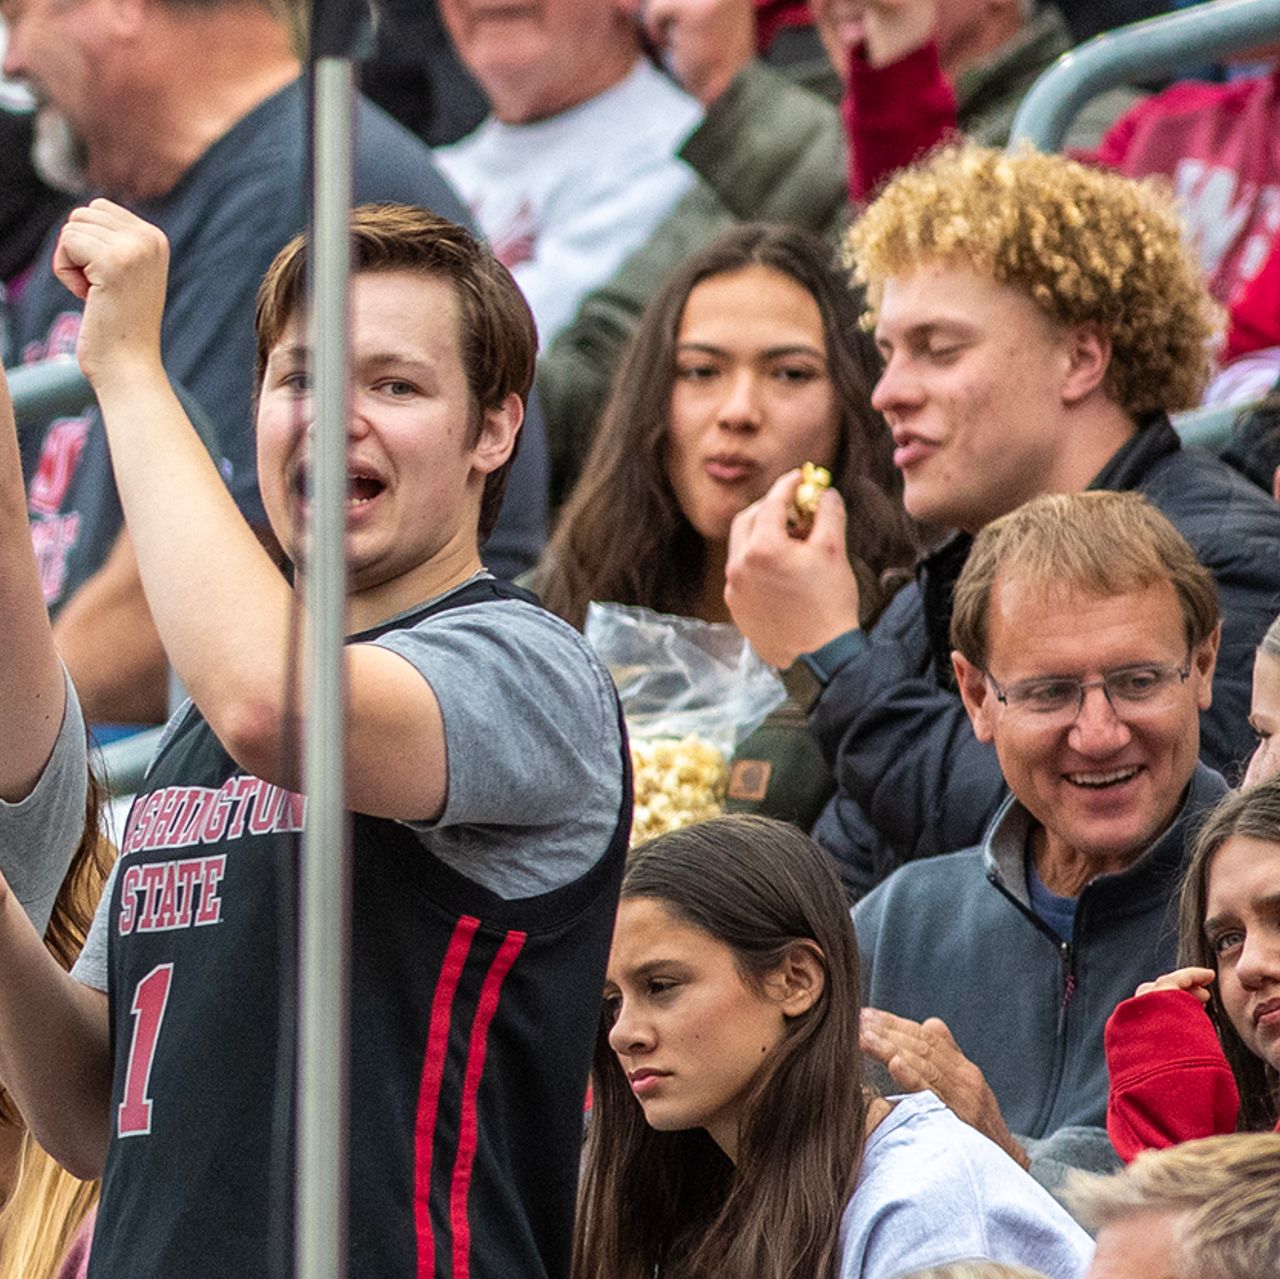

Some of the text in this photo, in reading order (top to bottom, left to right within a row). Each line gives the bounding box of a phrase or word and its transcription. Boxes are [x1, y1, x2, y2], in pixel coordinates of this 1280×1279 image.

[121, 775, 307, 858] SHINGTON
[119, 854, 227, 936] STATE
[117, 962, 175, 1138] 1
